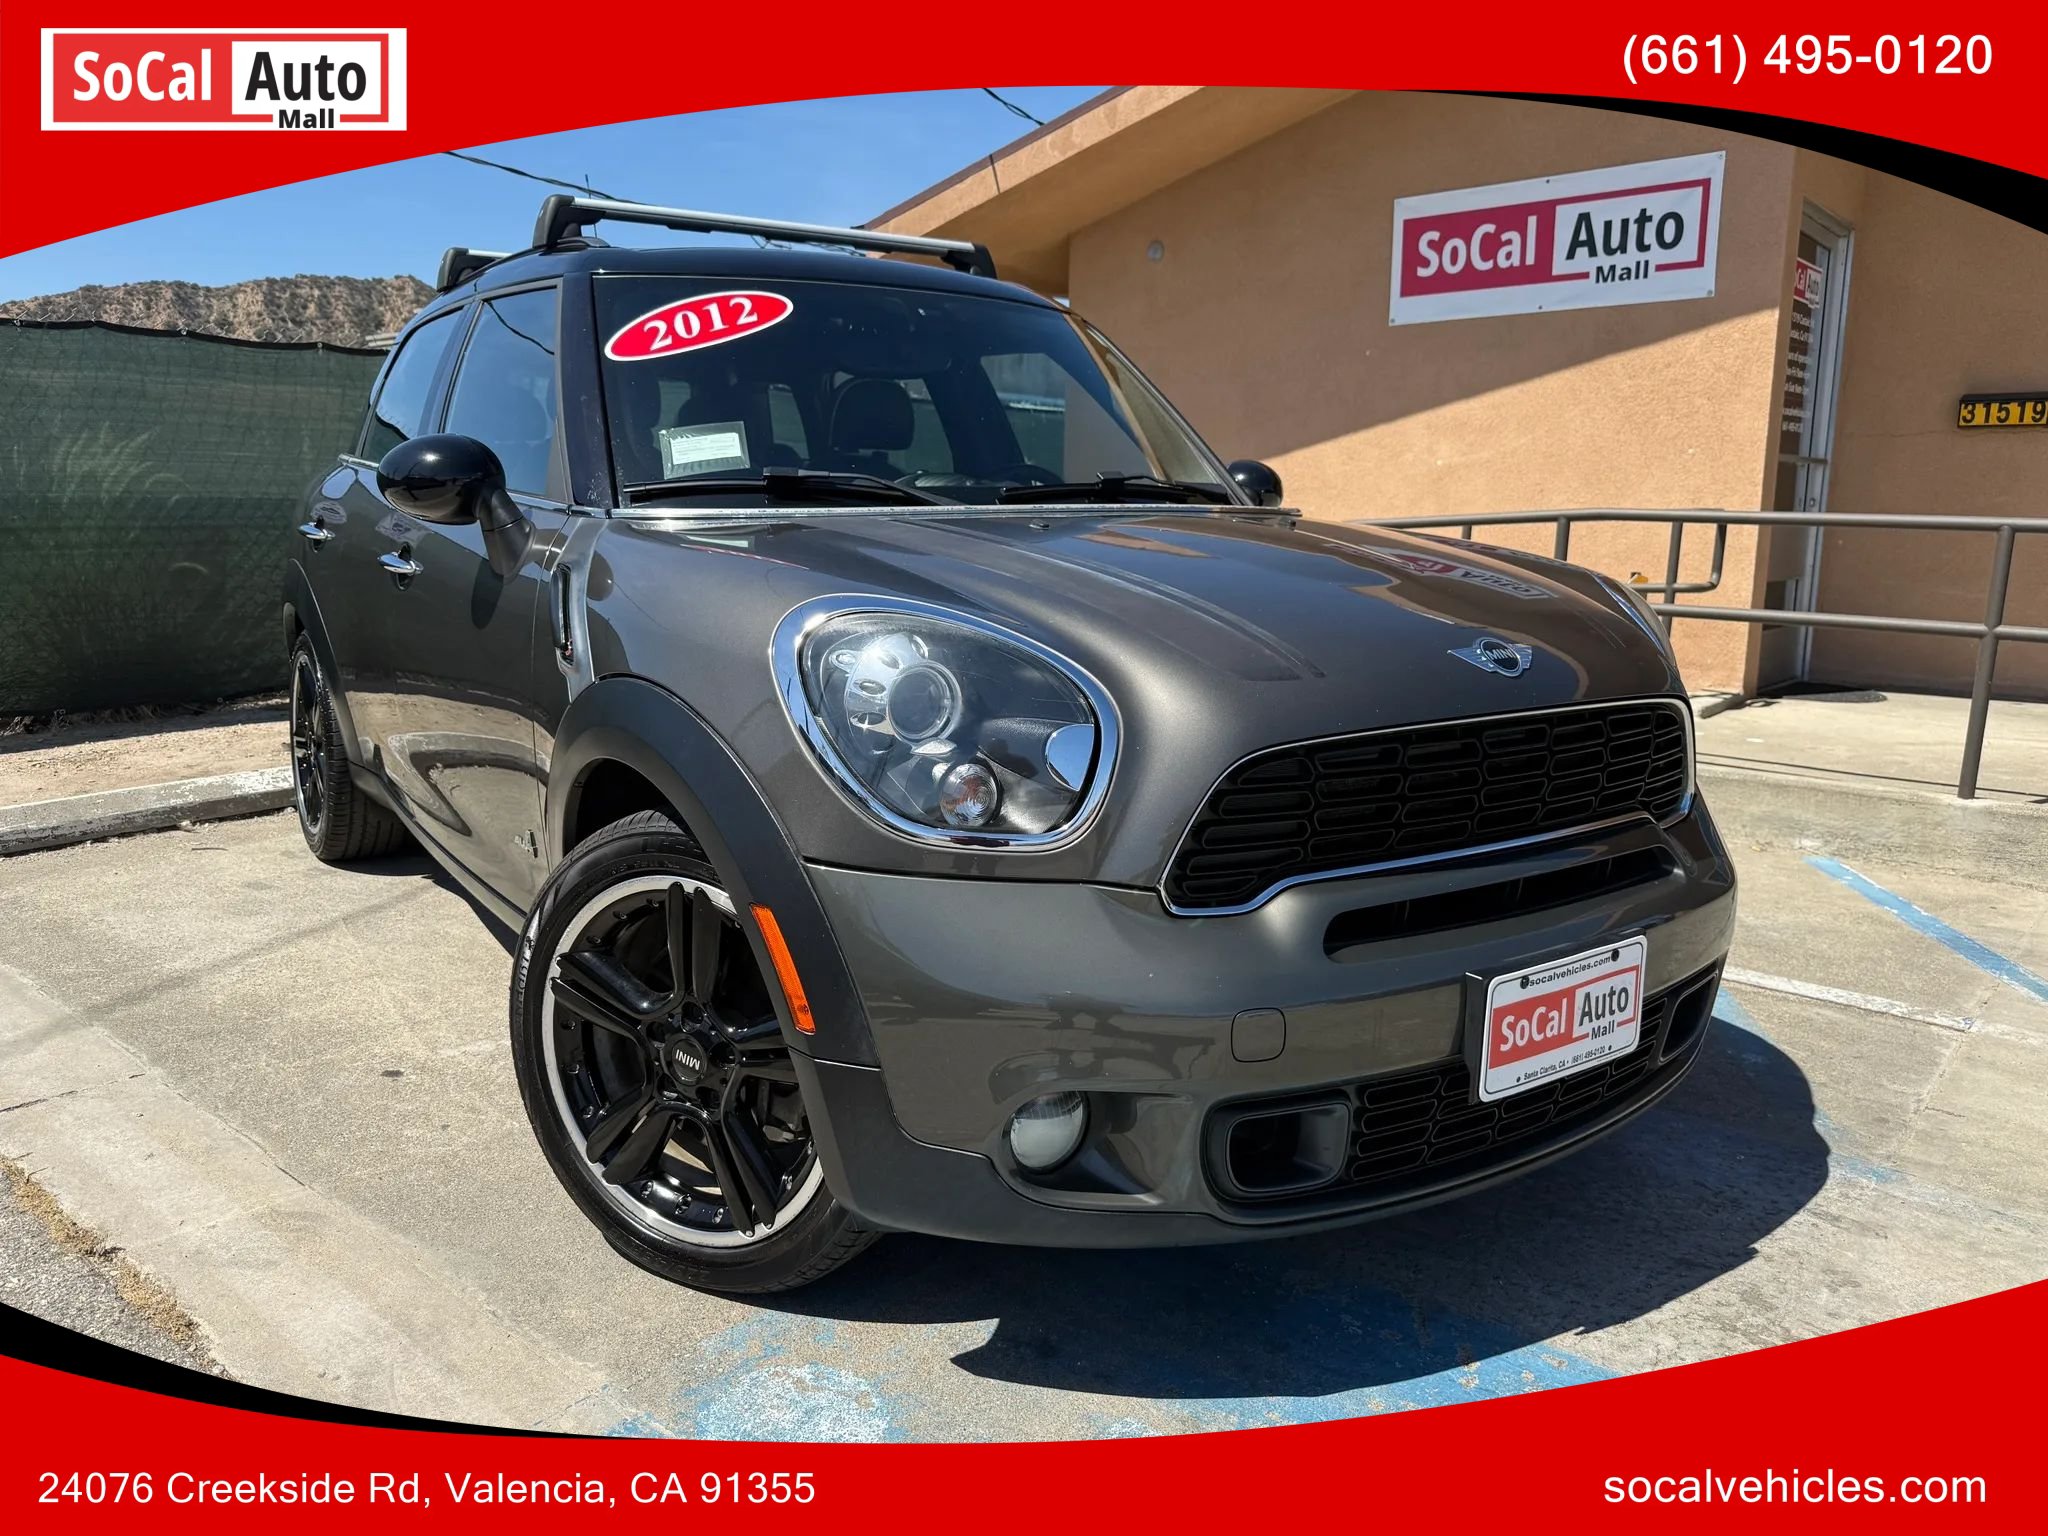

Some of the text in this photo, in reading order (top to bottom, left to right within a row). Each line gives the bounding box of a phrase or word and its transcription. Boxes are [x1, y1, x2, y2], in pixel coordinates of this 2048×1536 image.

[1416, 208, 1685, 278] SoCal Auto
[1595, 260, 1648, 284] Mall
[643, 297, 758, 351] 2012
[1961, 400, 2047, 424] 31519
[1485, 648, 1517, 661] MINI
[1528, 956, 1612, 987] socalvehicles.com
[1500, 986, 1629, 1052] SoCal Auto
[1591, 1020, 1615, 1041] Mall
[675, 1049, 701, 1071] MINI
